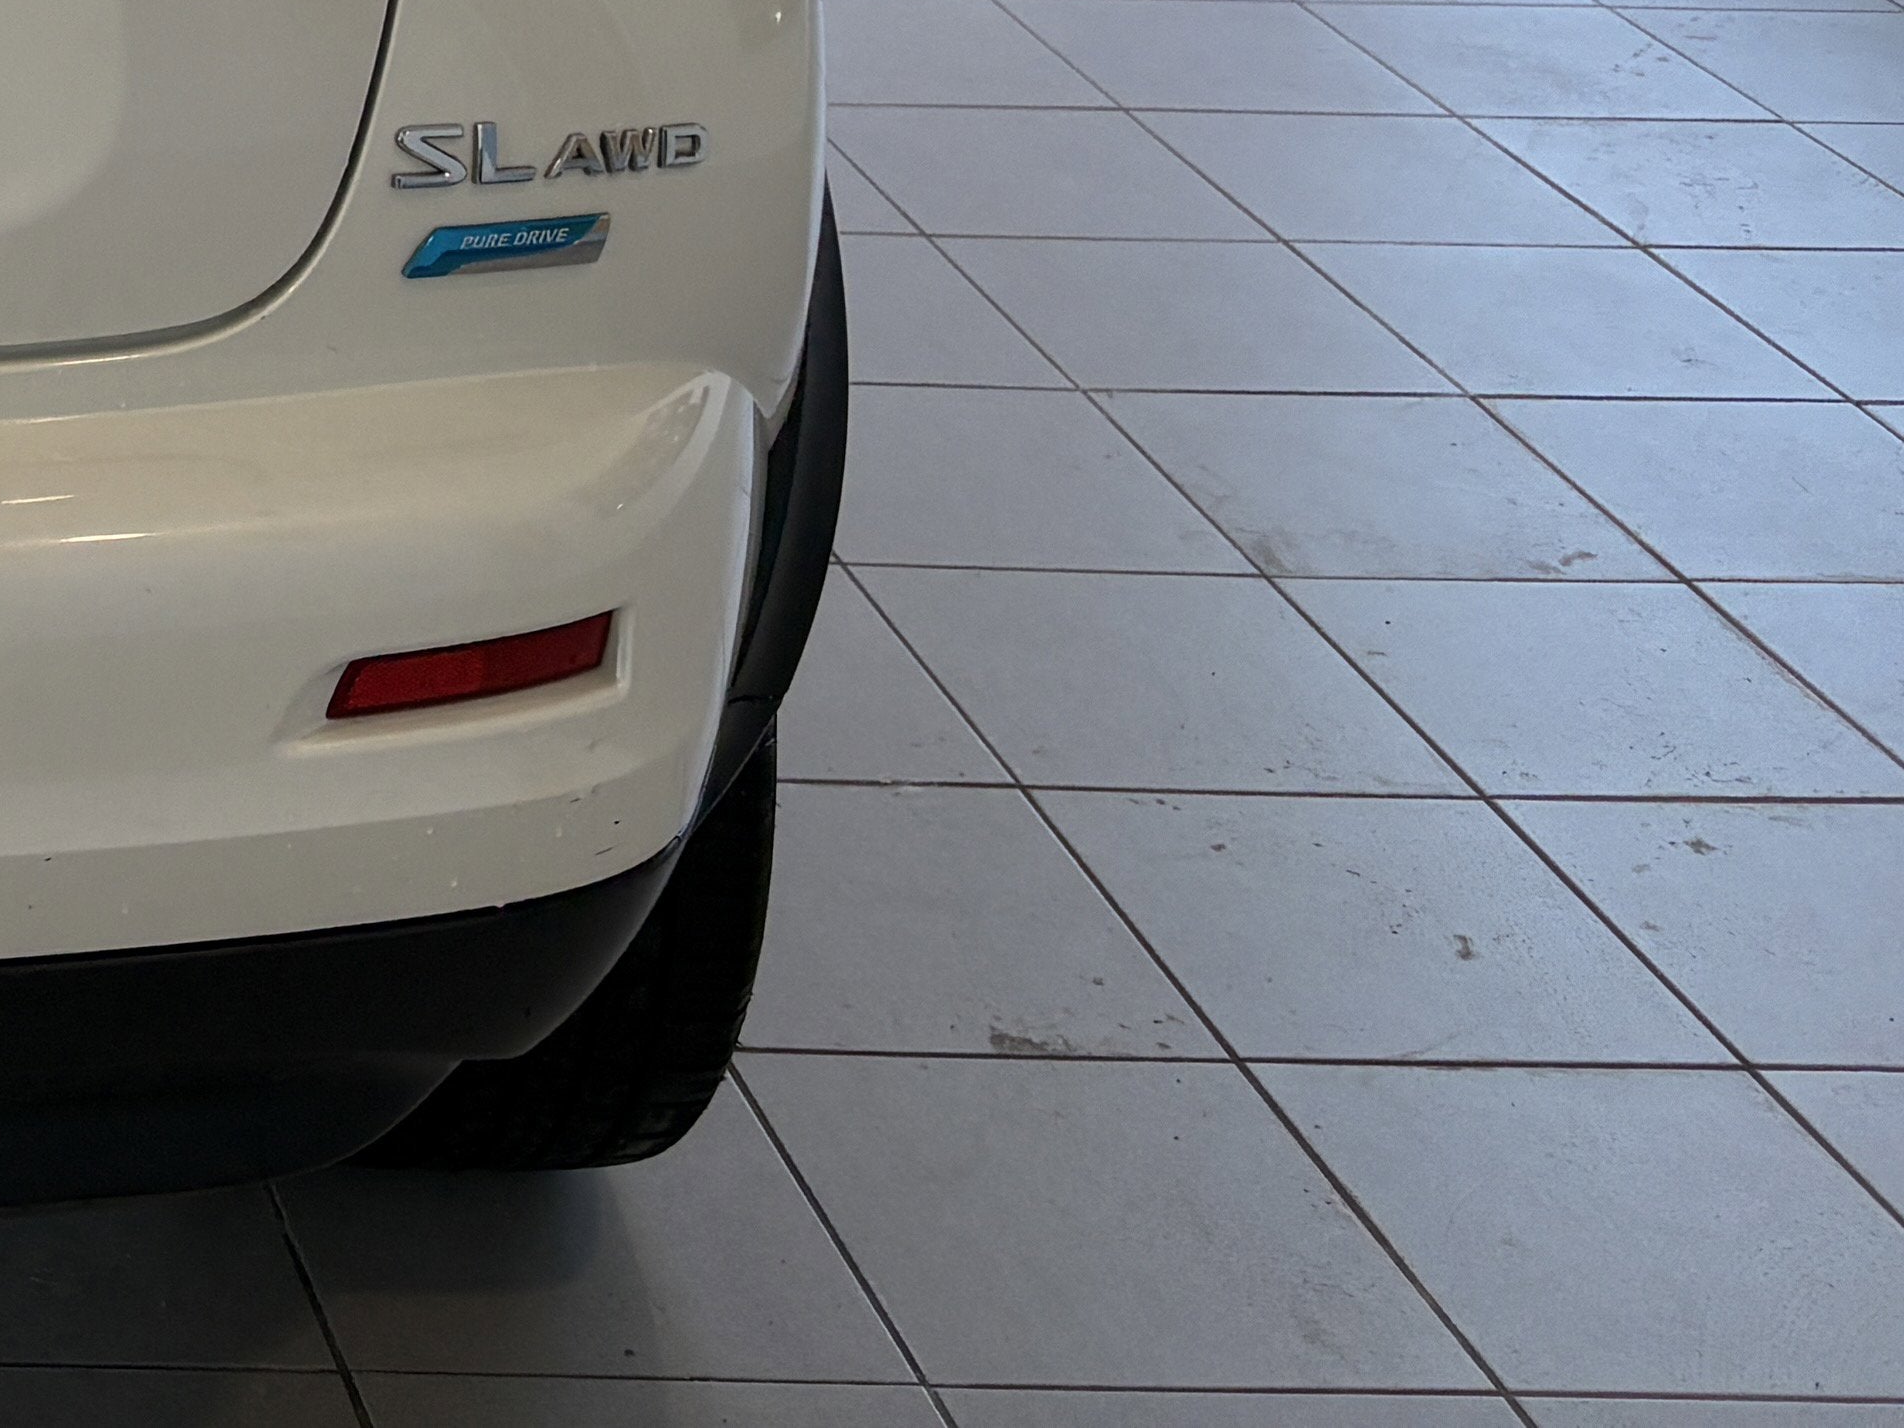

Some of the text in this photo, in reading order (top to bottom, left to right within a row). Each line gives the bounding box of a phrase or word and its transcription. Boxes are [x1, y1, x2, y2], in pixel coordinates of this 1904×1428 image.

[390, 121, 712, 190] SL AWD
[459, 226, 571, 251] PURE DRIVE
